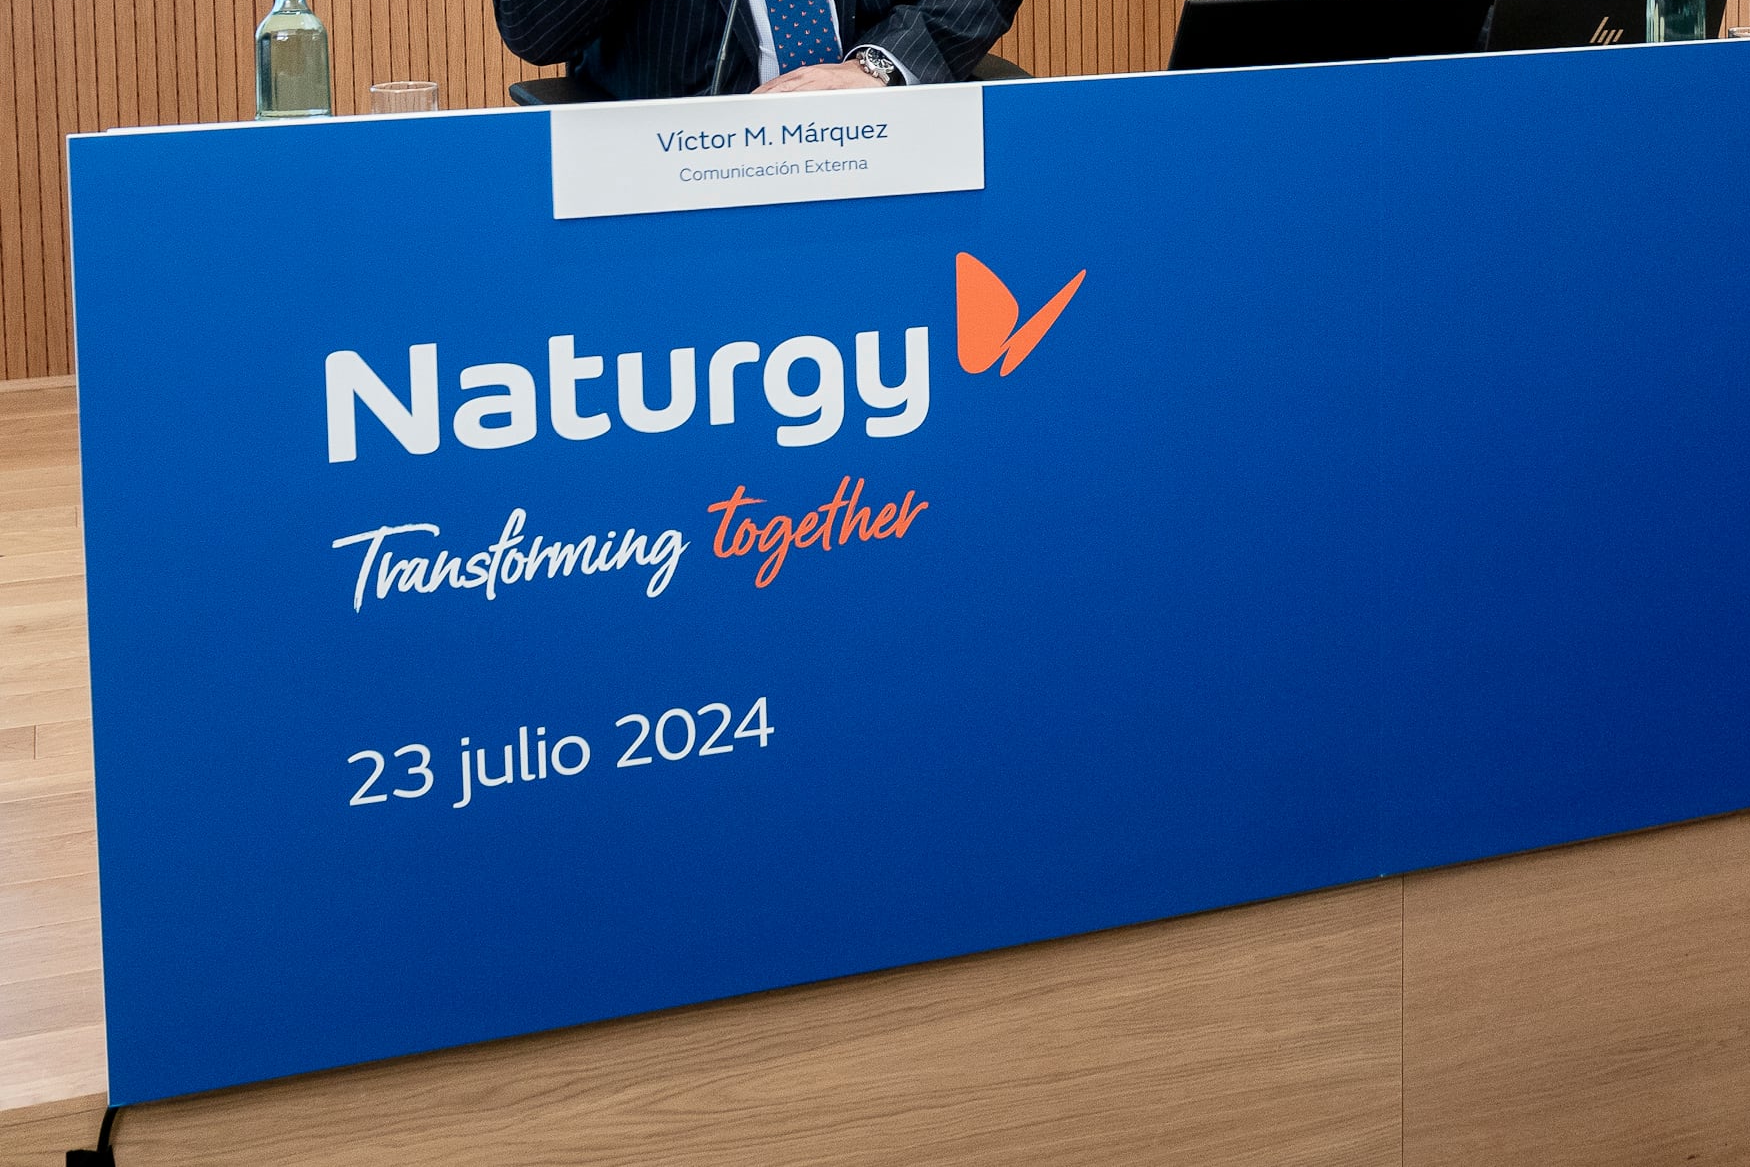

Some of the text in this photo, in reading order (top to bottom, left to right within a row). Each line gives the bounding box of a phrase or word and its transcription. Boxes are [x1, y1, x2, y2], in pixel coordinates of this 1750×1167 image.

[656, 120, 889, 153] Víctor M. Márquez
[679, 158, 869, 183] Comunicación Externa
[326, 327, 930, 462] Naturgy
[332, 475, 930, 613] Transforming together
[347, 695, 776, 810] 23 julio 2024
